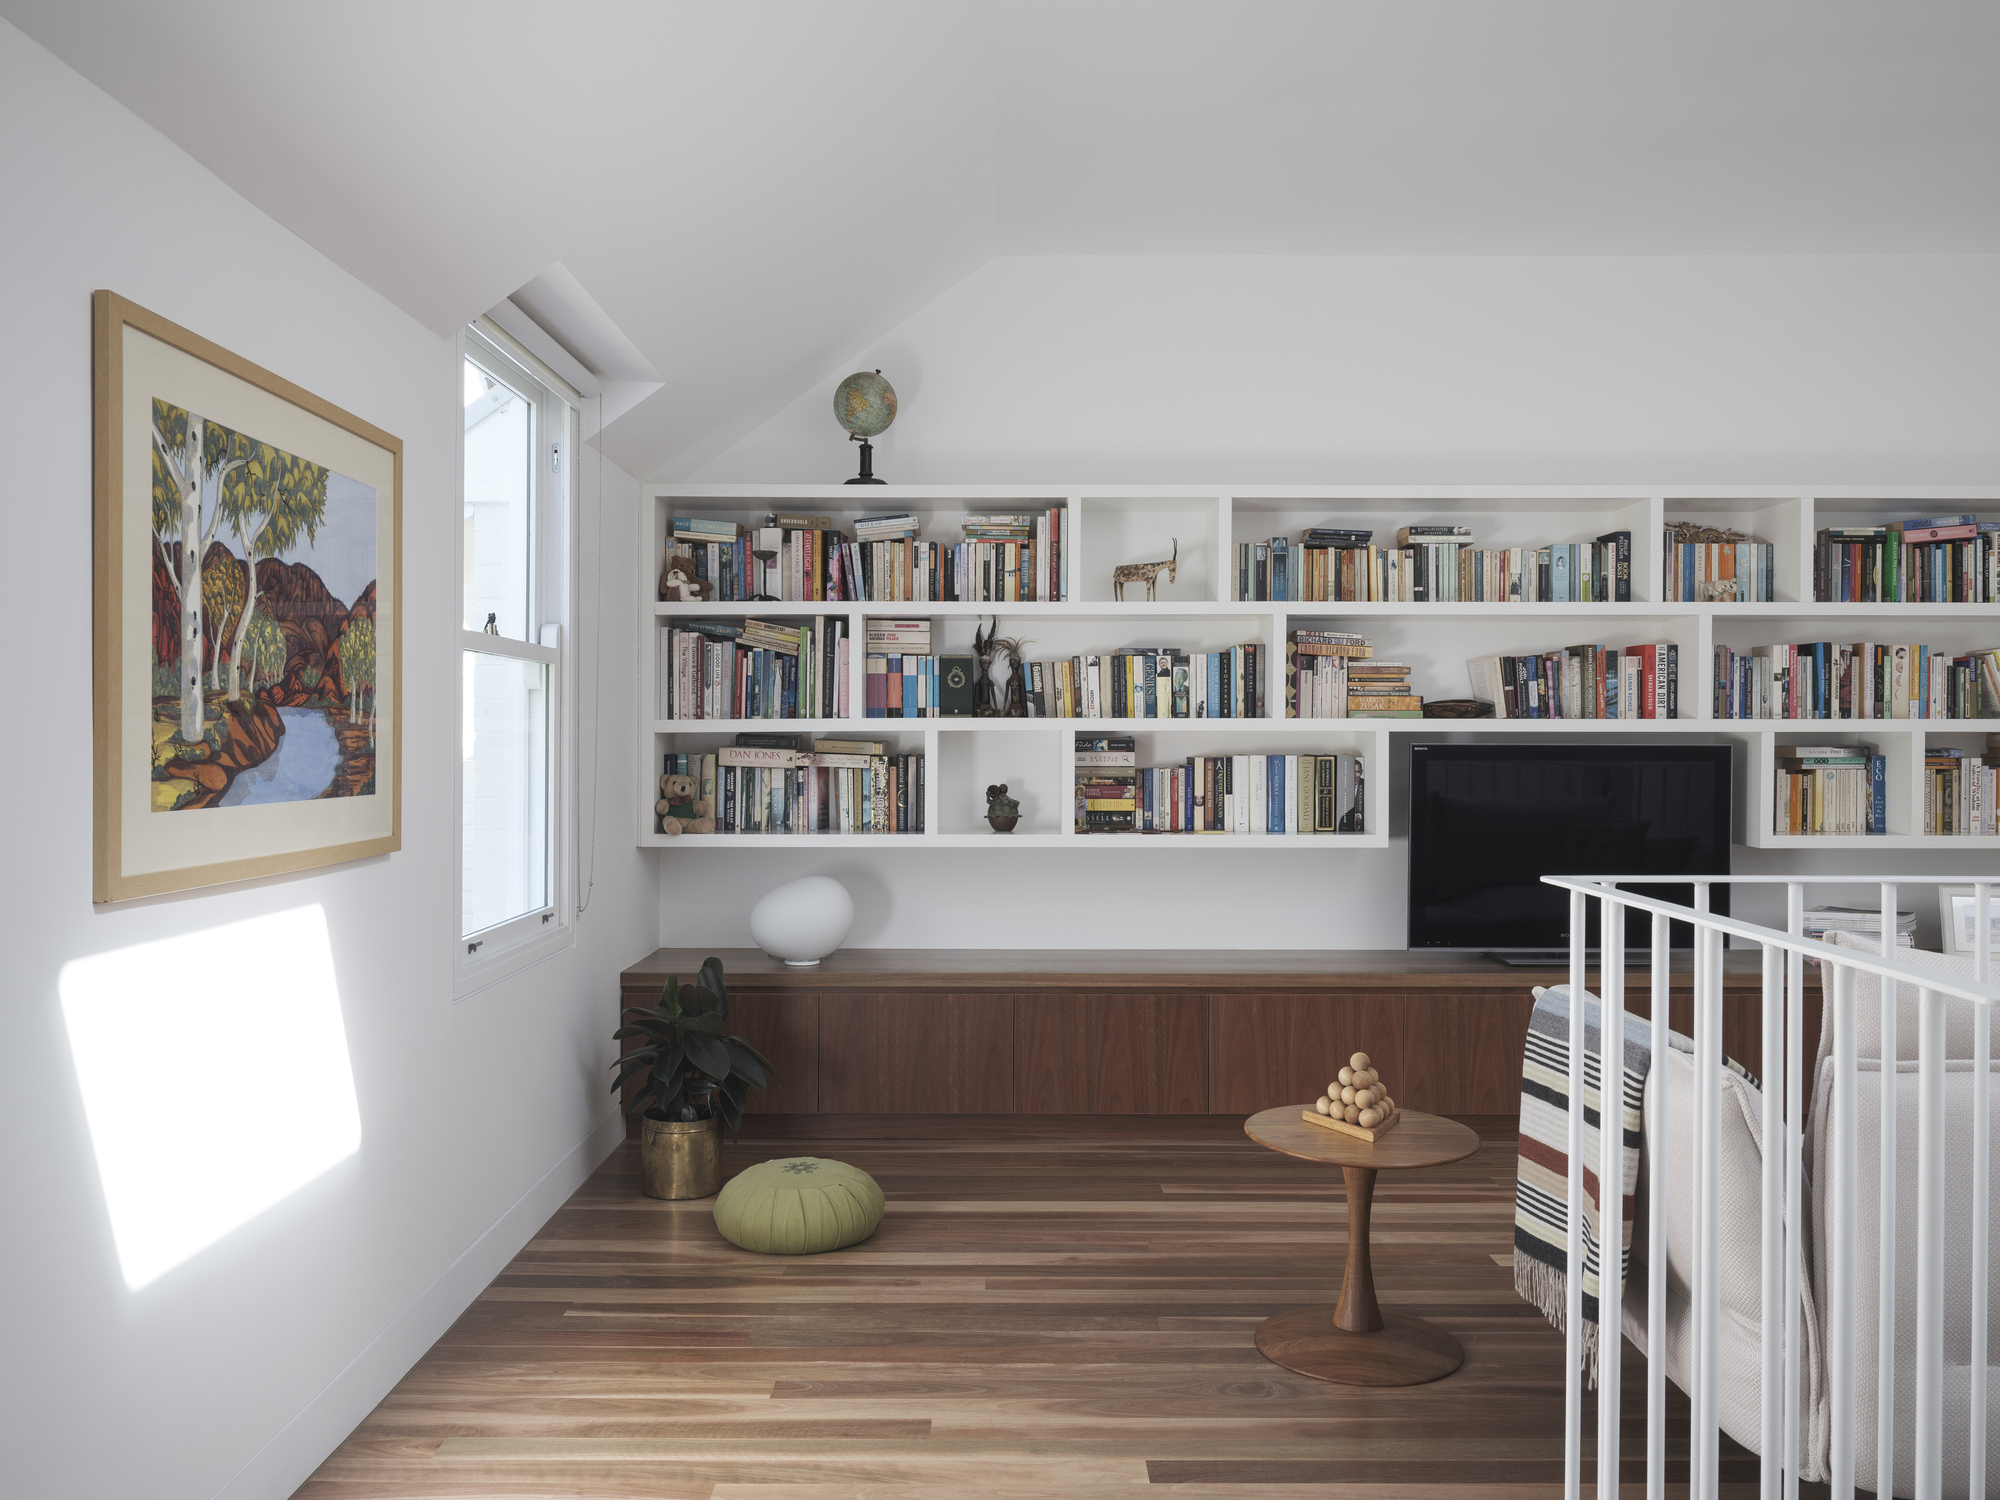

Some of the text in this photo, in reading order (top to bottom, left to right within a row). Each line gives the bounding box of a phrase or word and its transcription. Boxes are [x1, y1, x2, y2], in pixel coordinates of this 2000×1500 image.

[1326, 645, 1350, 655] RICHARD
[1351, 647, 1366, 656] FORD
[1033, 666, 1042, 692] Gandhi
[1145, 663, 1155, 695] GENIUS
[1657, 652, 1665, 709] AMERICAN DIRT
[730, 750, 780, 760] DAN JONES
